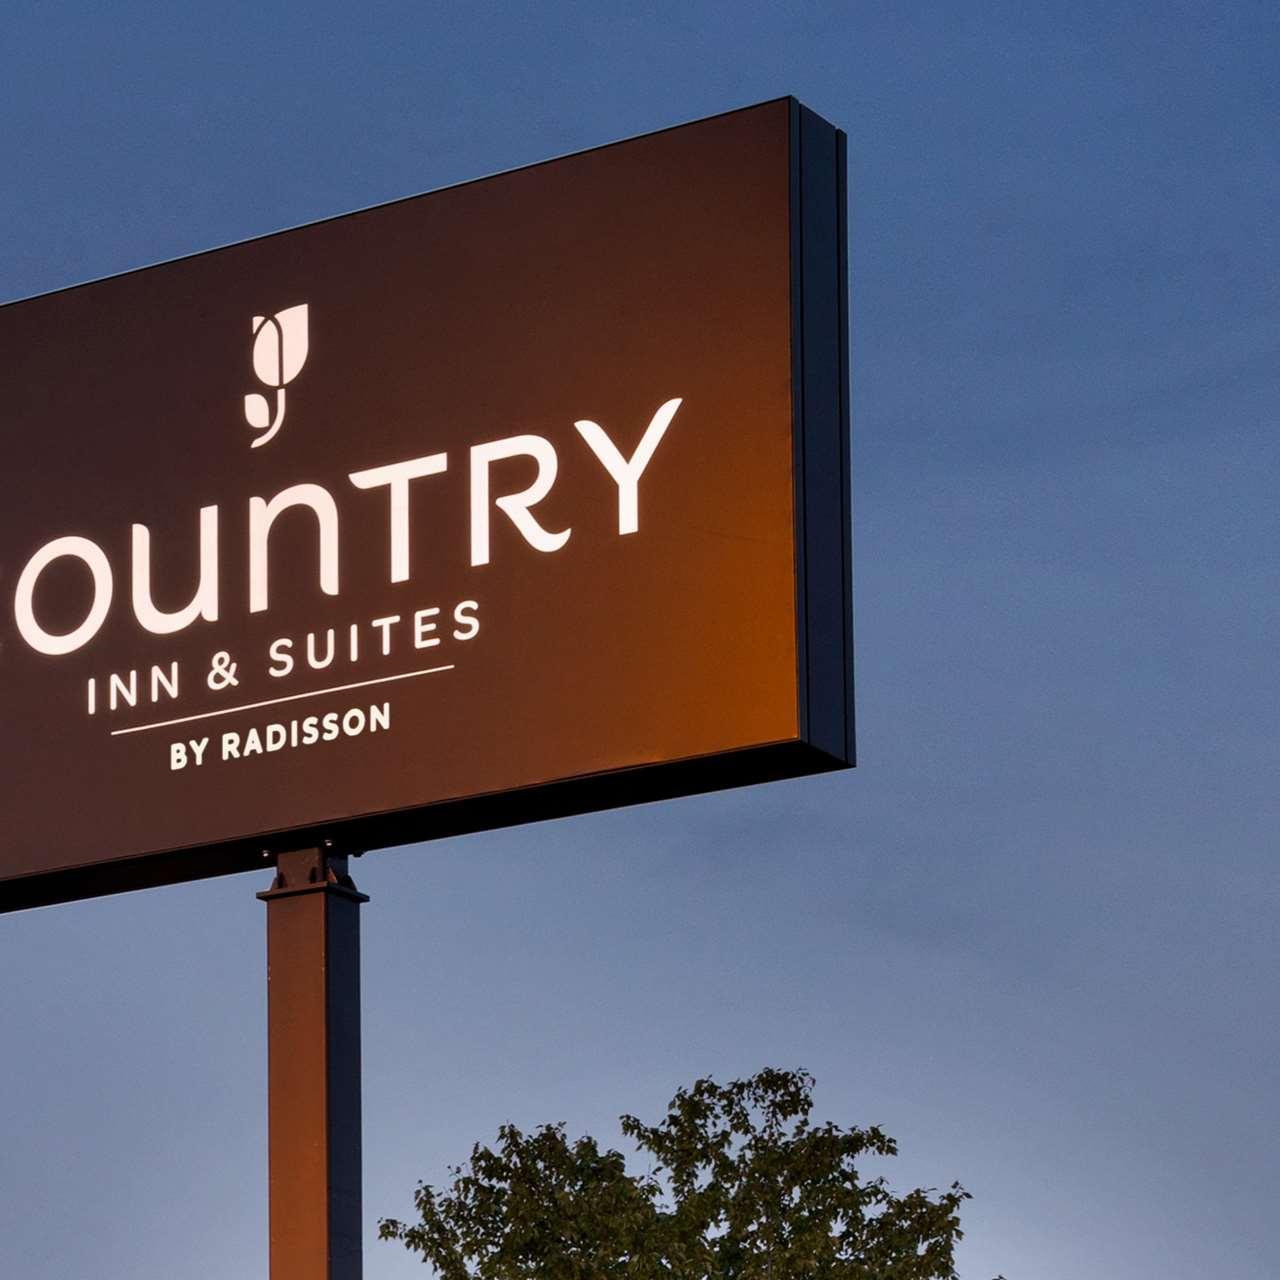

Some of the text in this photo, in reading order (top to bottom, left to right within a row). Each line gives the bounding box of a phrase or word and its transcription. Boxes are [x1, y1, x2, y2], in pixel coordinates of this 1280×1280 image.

[88, 601, 480, 715] INN & SUITES
[171, 703, 390, 771] BY RADISSON
